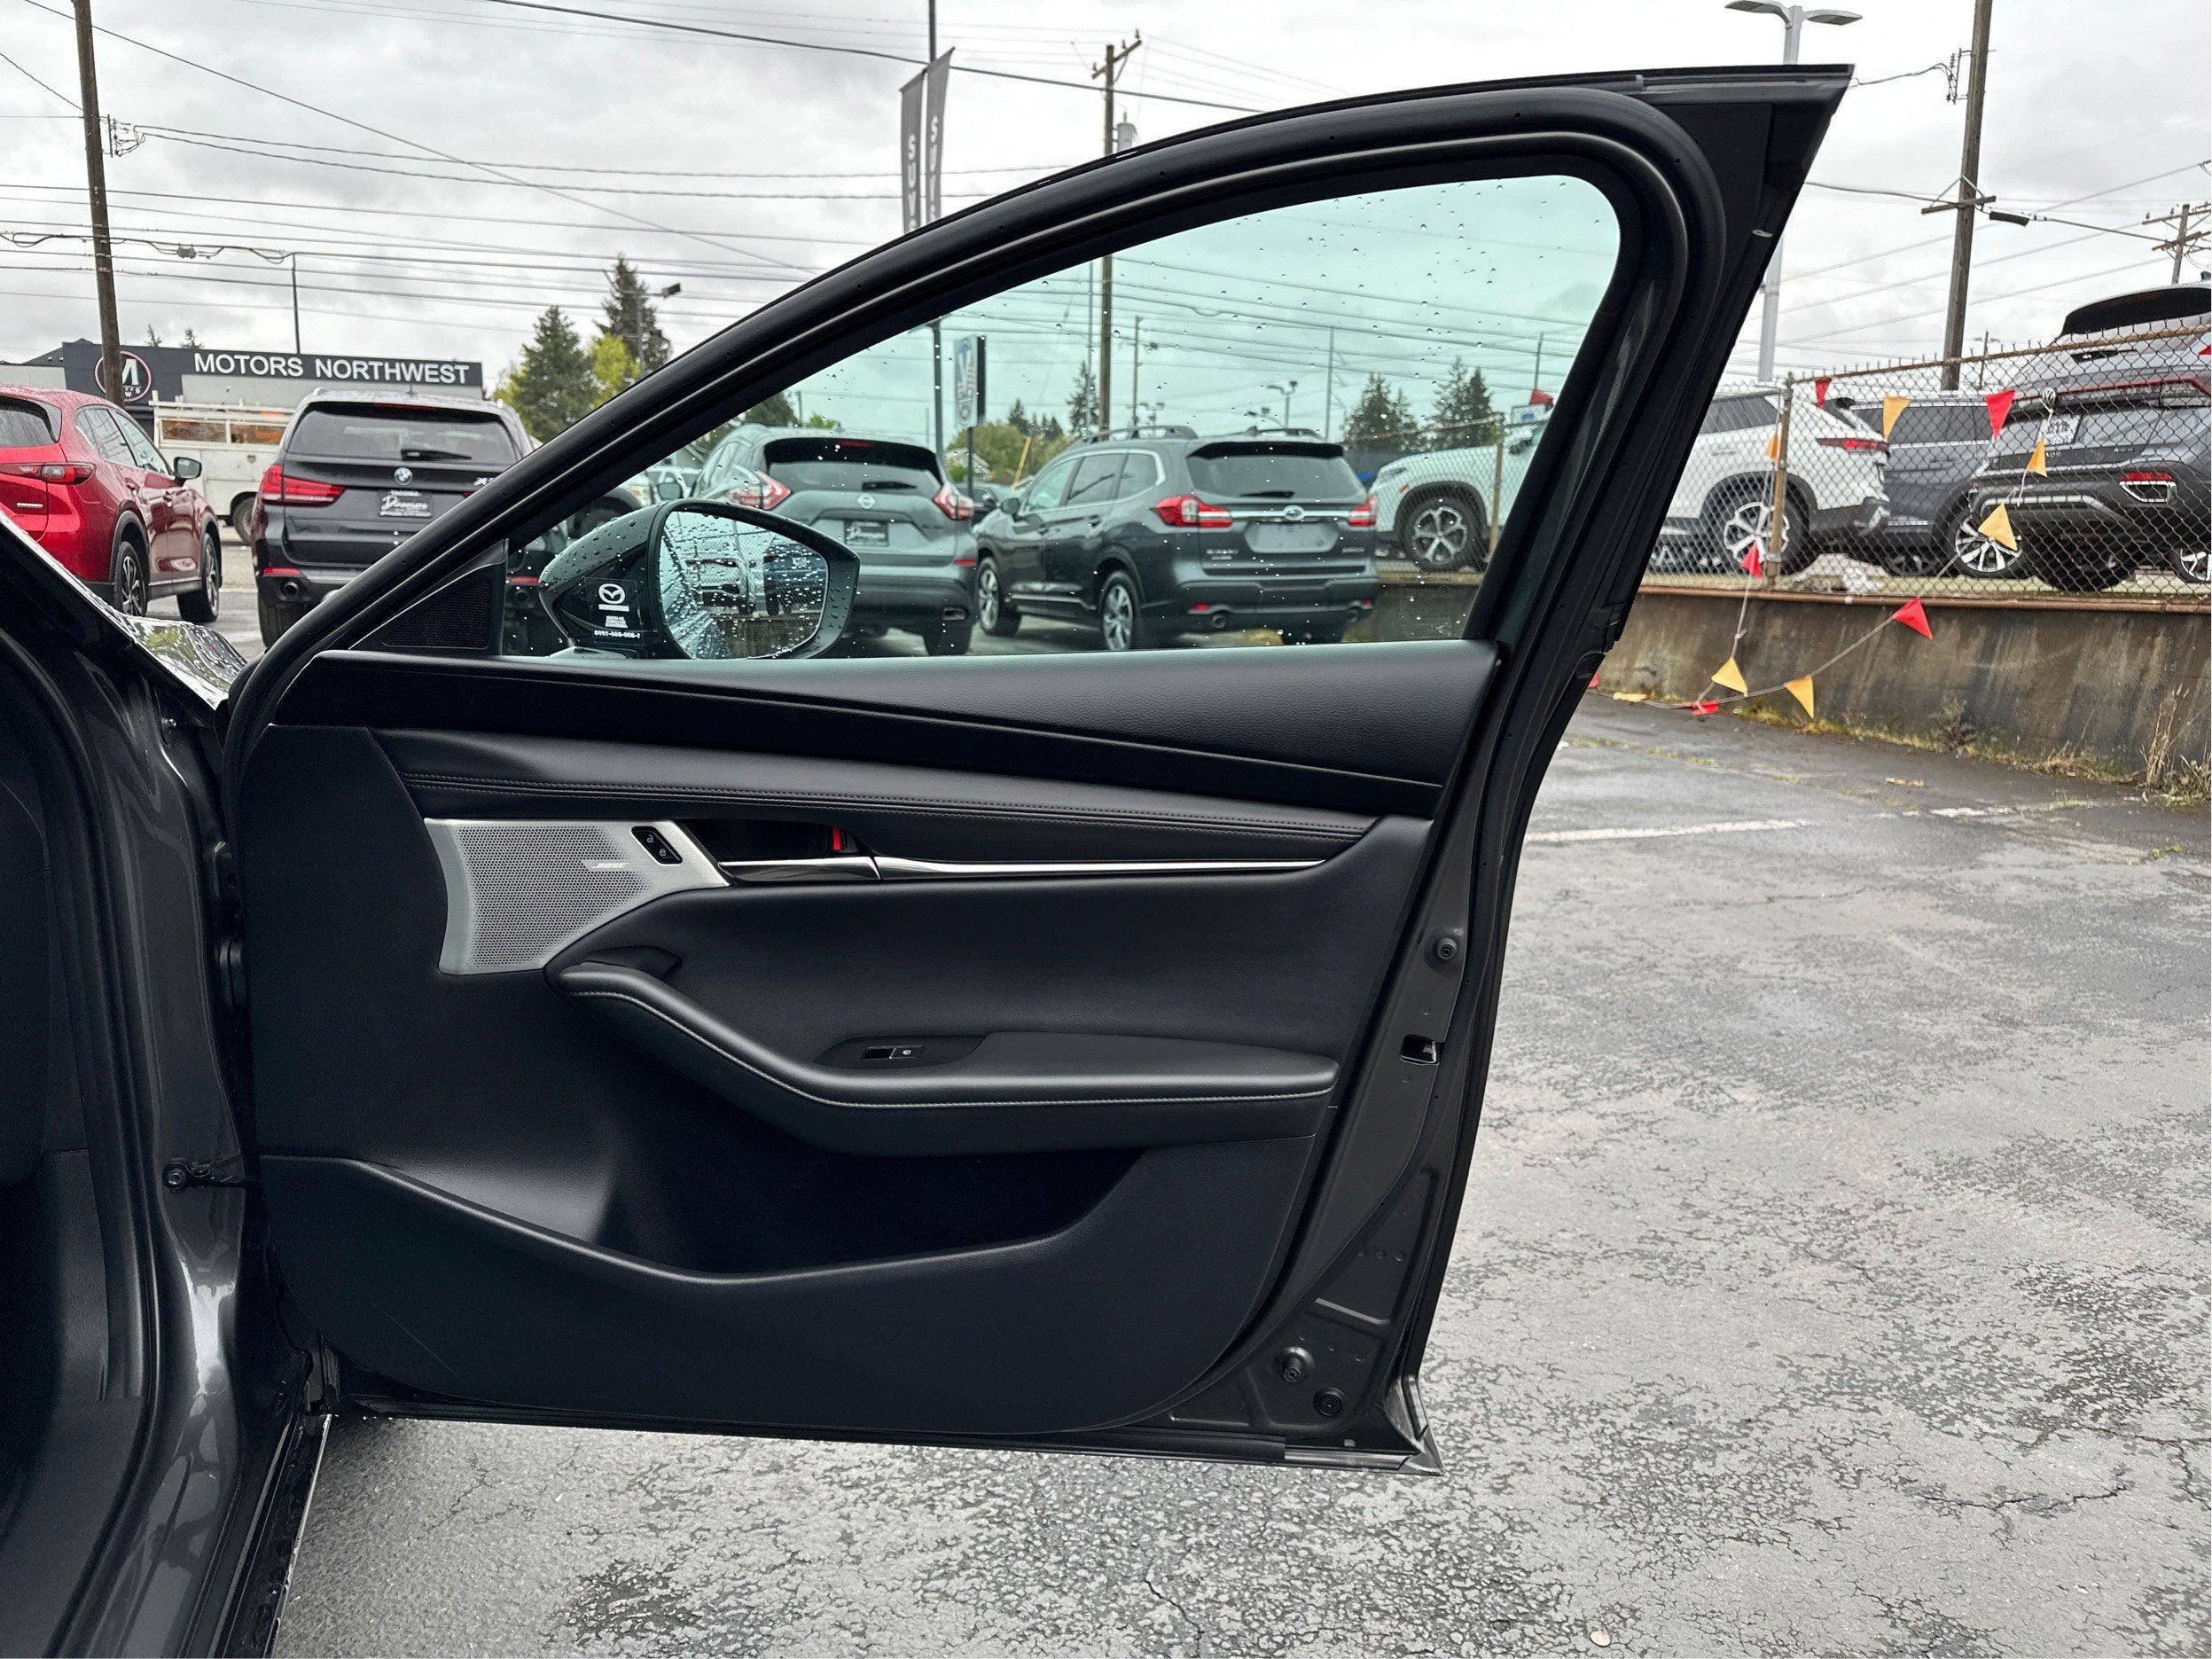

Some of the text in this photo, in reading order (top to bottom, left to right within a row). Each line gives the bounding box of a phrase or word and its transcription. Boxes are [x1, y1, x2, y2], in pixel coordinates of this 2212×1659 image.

[193, 352, 470, 384] MOTORS NORTHWEST
[473, 477, 496, 486] X
